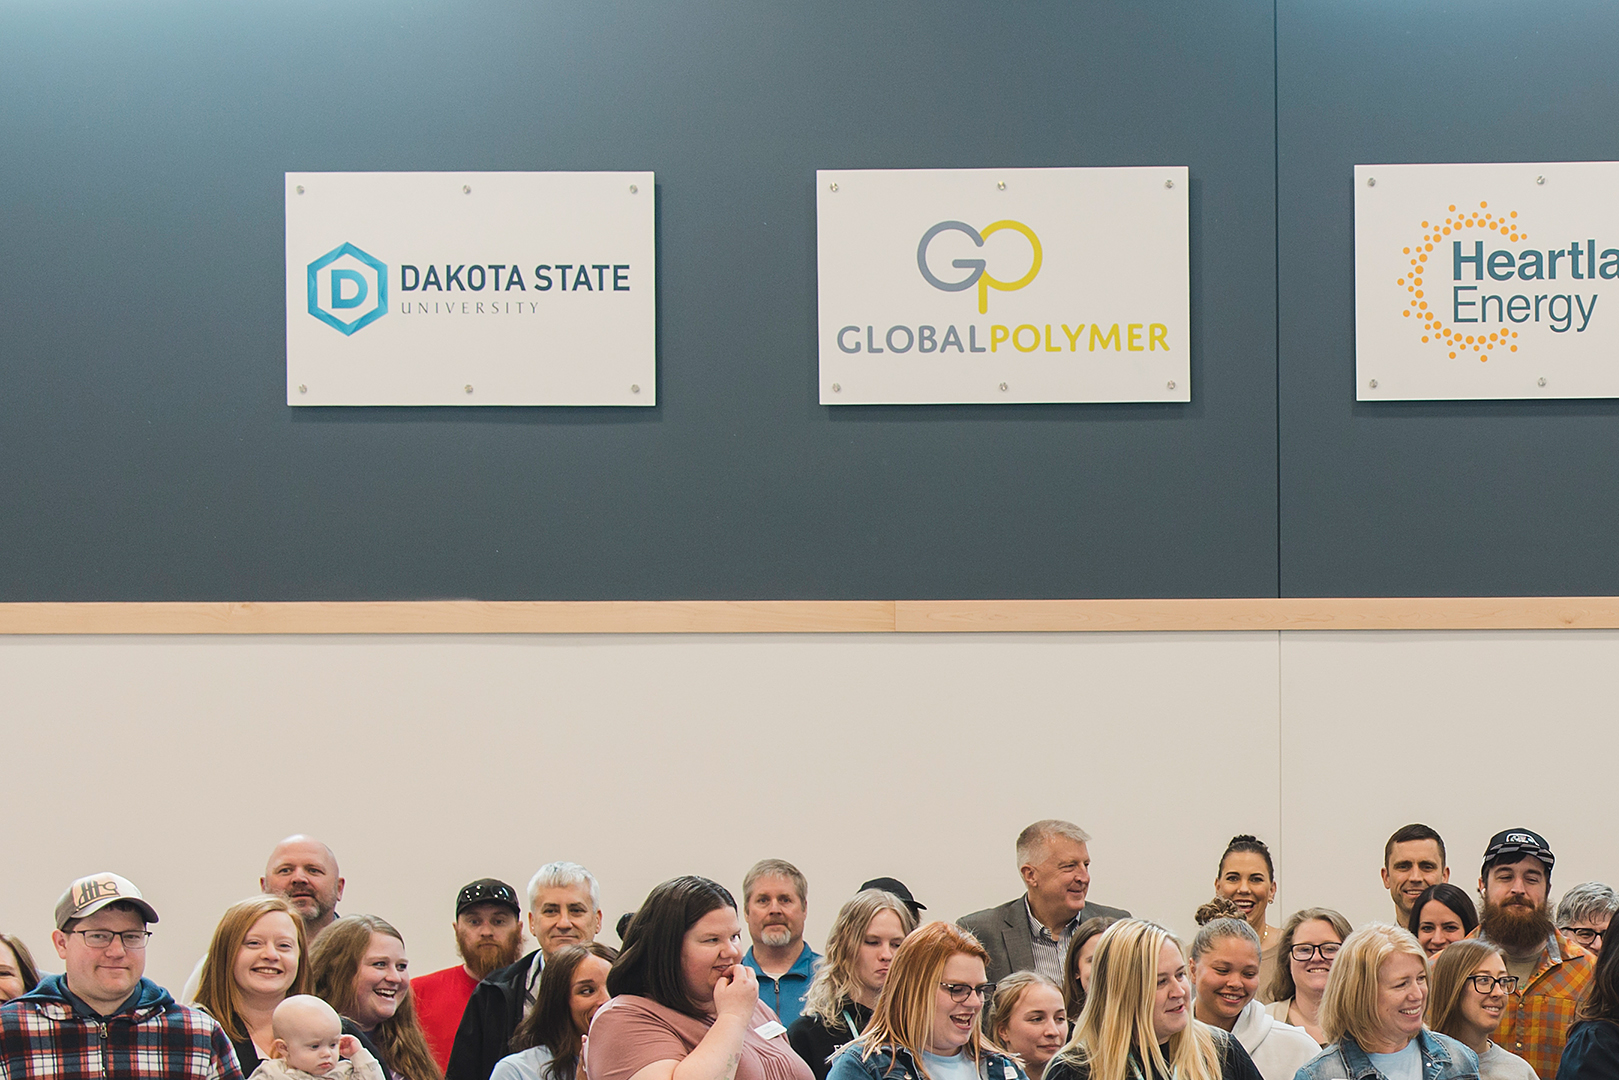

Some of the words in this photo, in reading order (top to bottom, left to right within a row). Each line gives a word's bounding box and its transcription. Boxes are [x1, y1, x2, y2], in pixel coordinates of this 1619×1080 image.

[331, 269, 368, 309] D
[401, 264, 527, 291] DAKOTA
[534, 264, 631, 292] STATE
[401, 302, 539, 315] UNIVERSITY
[1453, 285, 1599, 333] Energy
